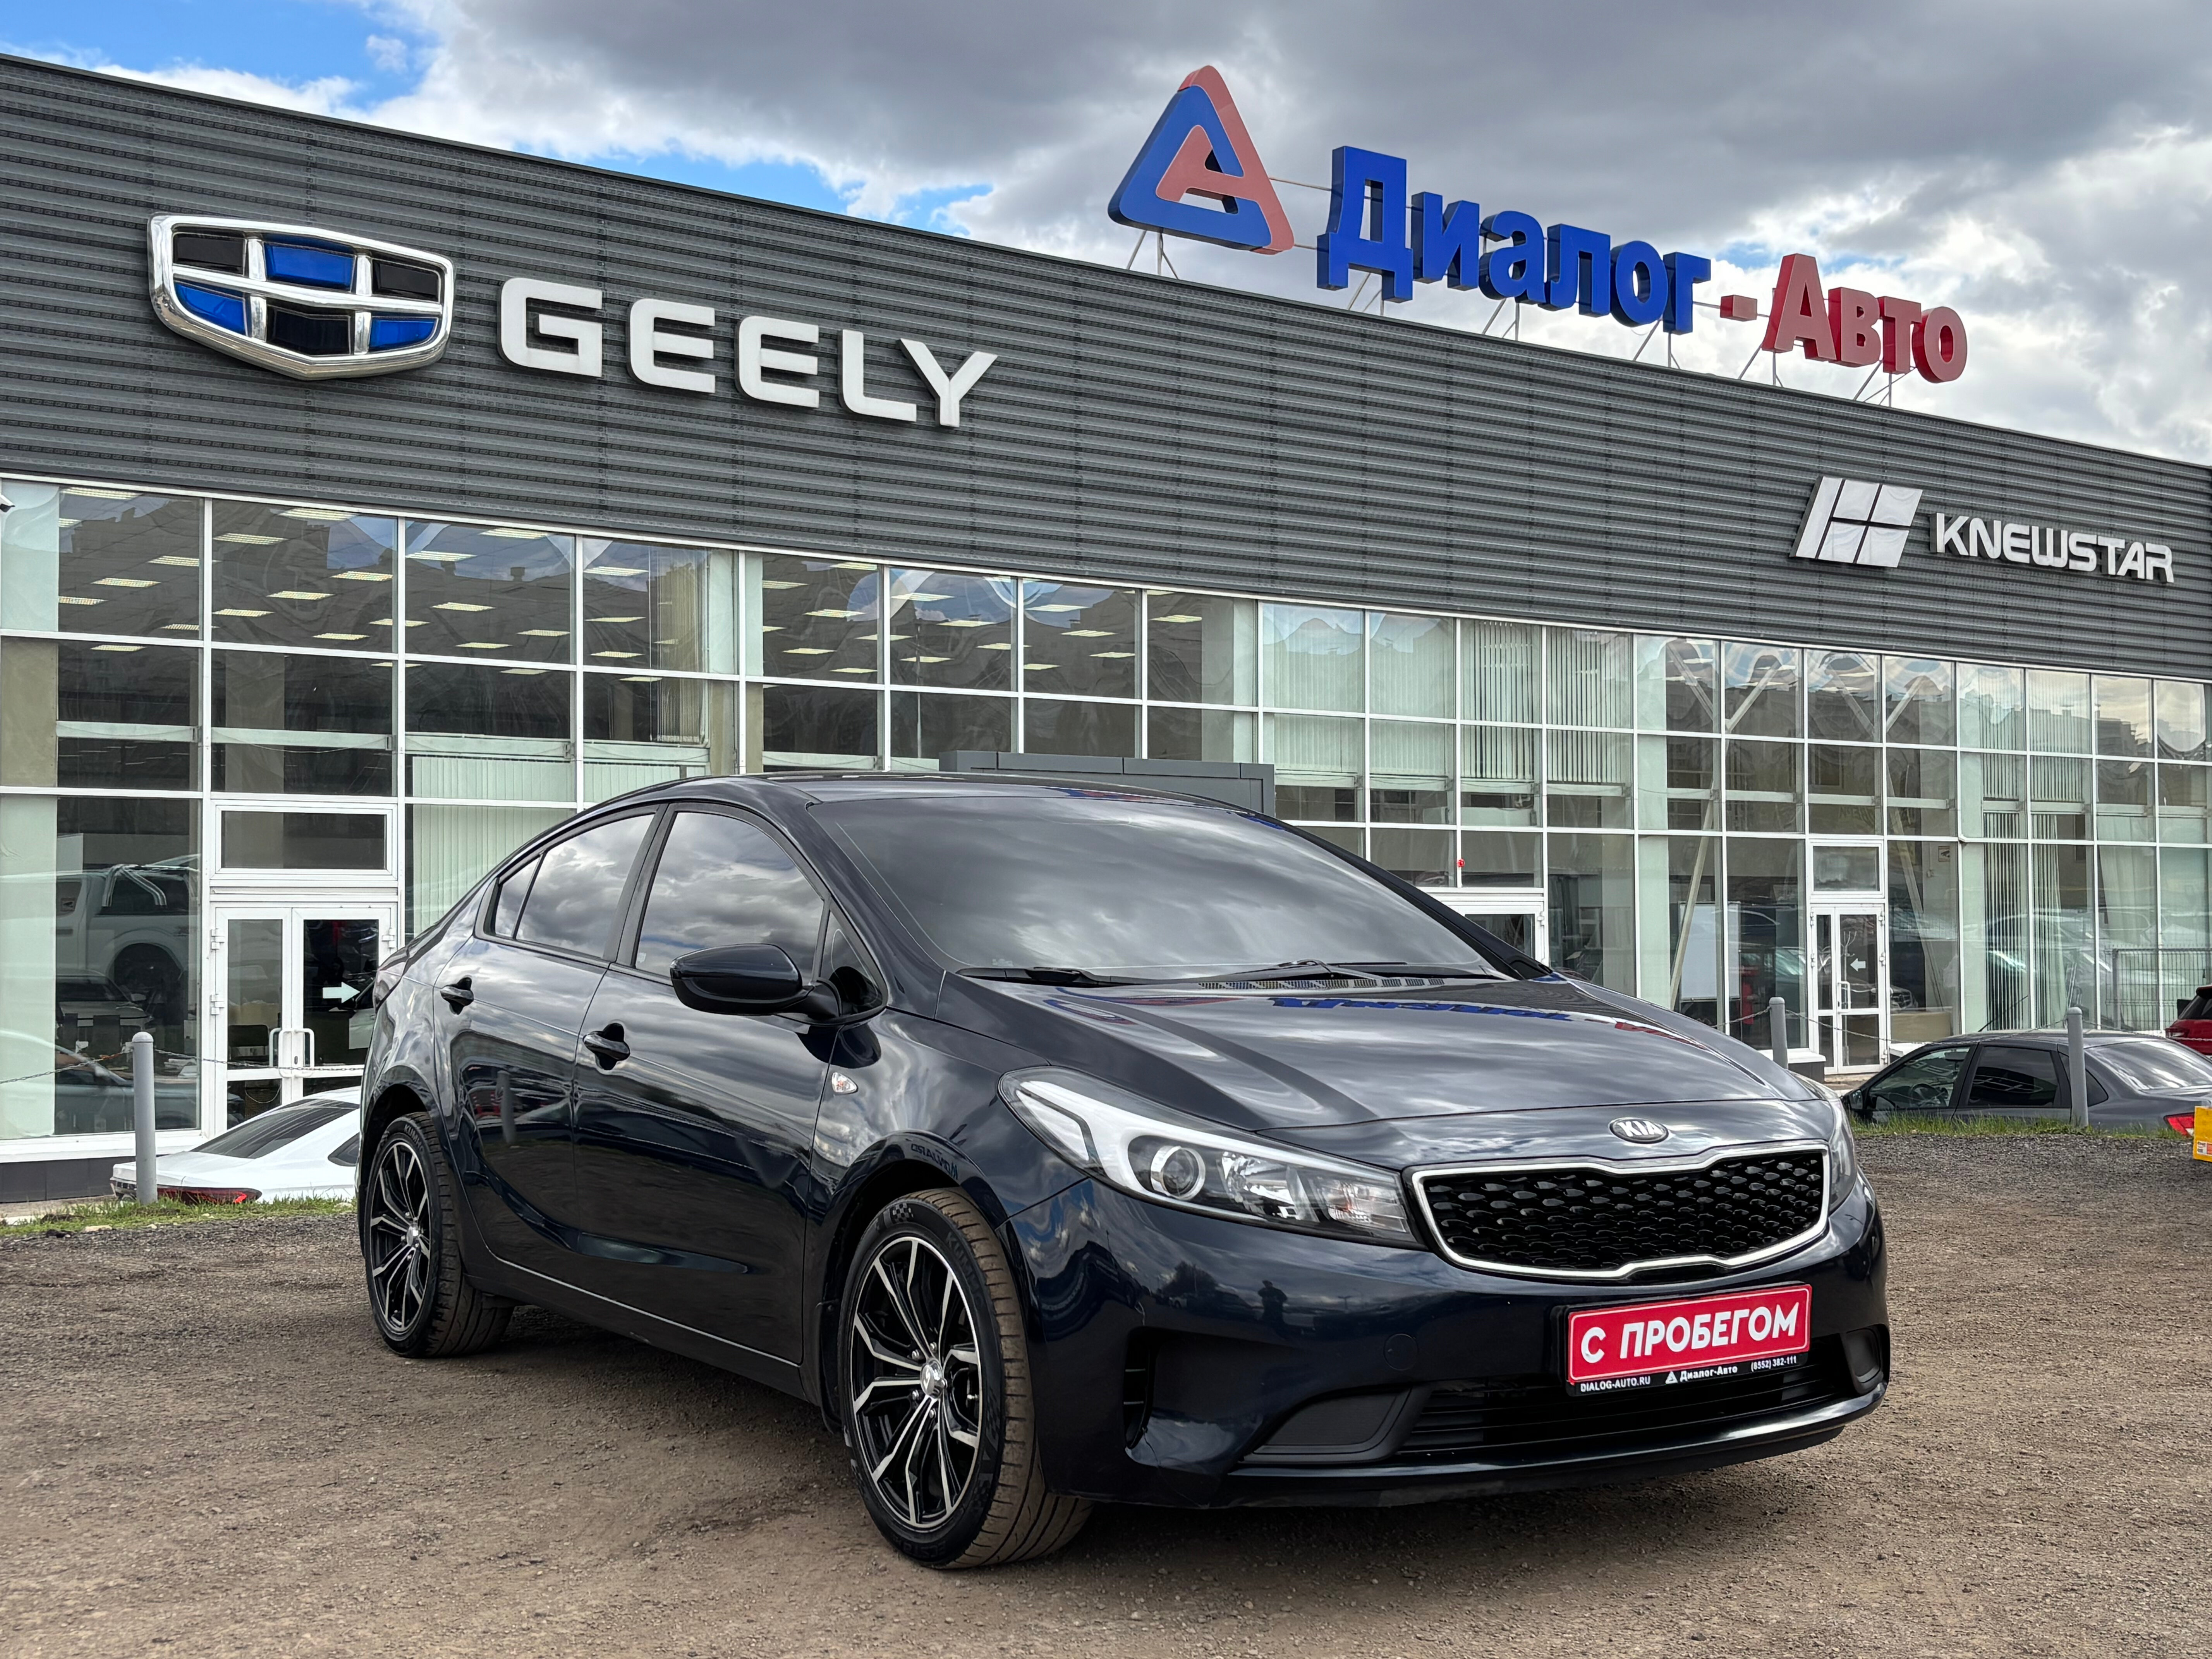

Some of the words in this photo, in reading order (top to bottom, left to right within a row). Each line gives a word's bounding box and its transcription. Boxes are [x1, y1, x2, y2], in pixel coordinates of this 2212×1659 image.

[1316, 145, 1967, 384] Диалог-Авто
[497, 277, 998, 428] GEELY
[1932, 512, 2175, 583] KNEWSTAR
[404, 1124, 425, 1153] KUMHO
[1617, 1120, 1664, 1137] KIA
[1580, 1326, 1606, 1364] С
[1619, 1302, 1800, 1359] ПРОБЕГОМ
[1680, 1365, 1738, 1382] Диалог-Авто
[1751, 1359, 1772, 1372] (8552)
[1772, 1355, 1797, 1367] 382-111
[1580, 1376, 1651, 1393] DIALOG-AUTO.RU
